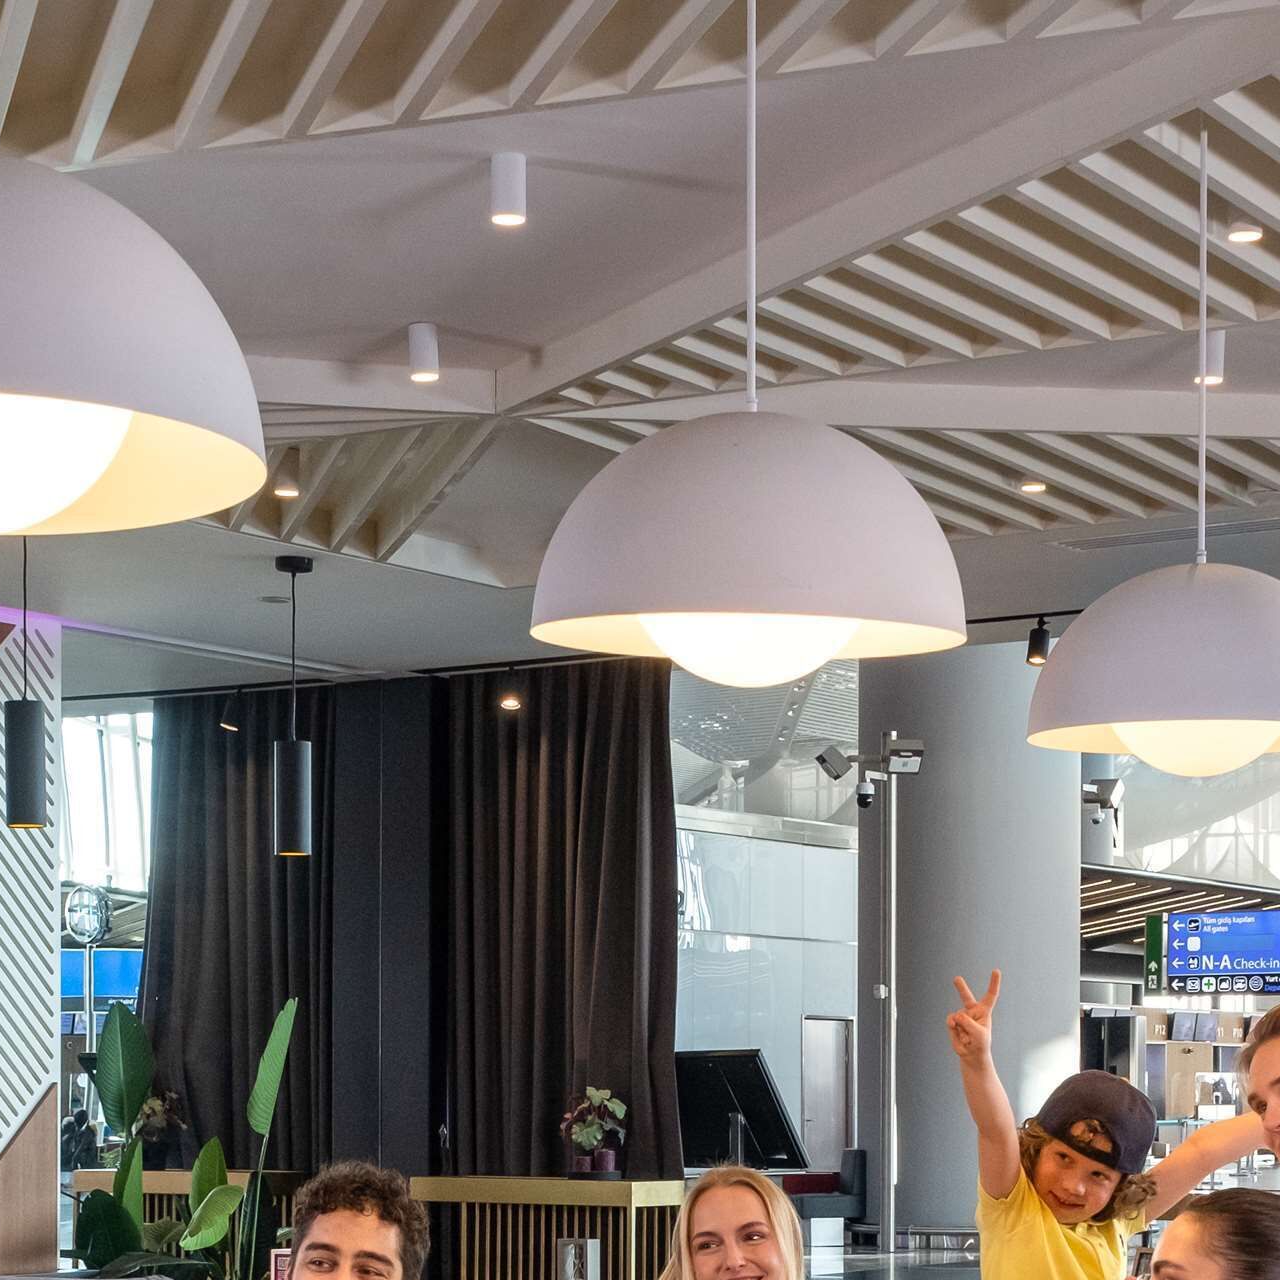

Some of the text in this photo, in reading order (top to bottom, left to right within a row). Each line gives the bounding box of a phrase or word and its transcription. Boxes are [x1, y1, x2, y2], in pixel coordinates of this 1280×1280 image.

[1201, 955, 1280, 970] N-A Check-in
[1154, 1024, 1166, 1035] P12
